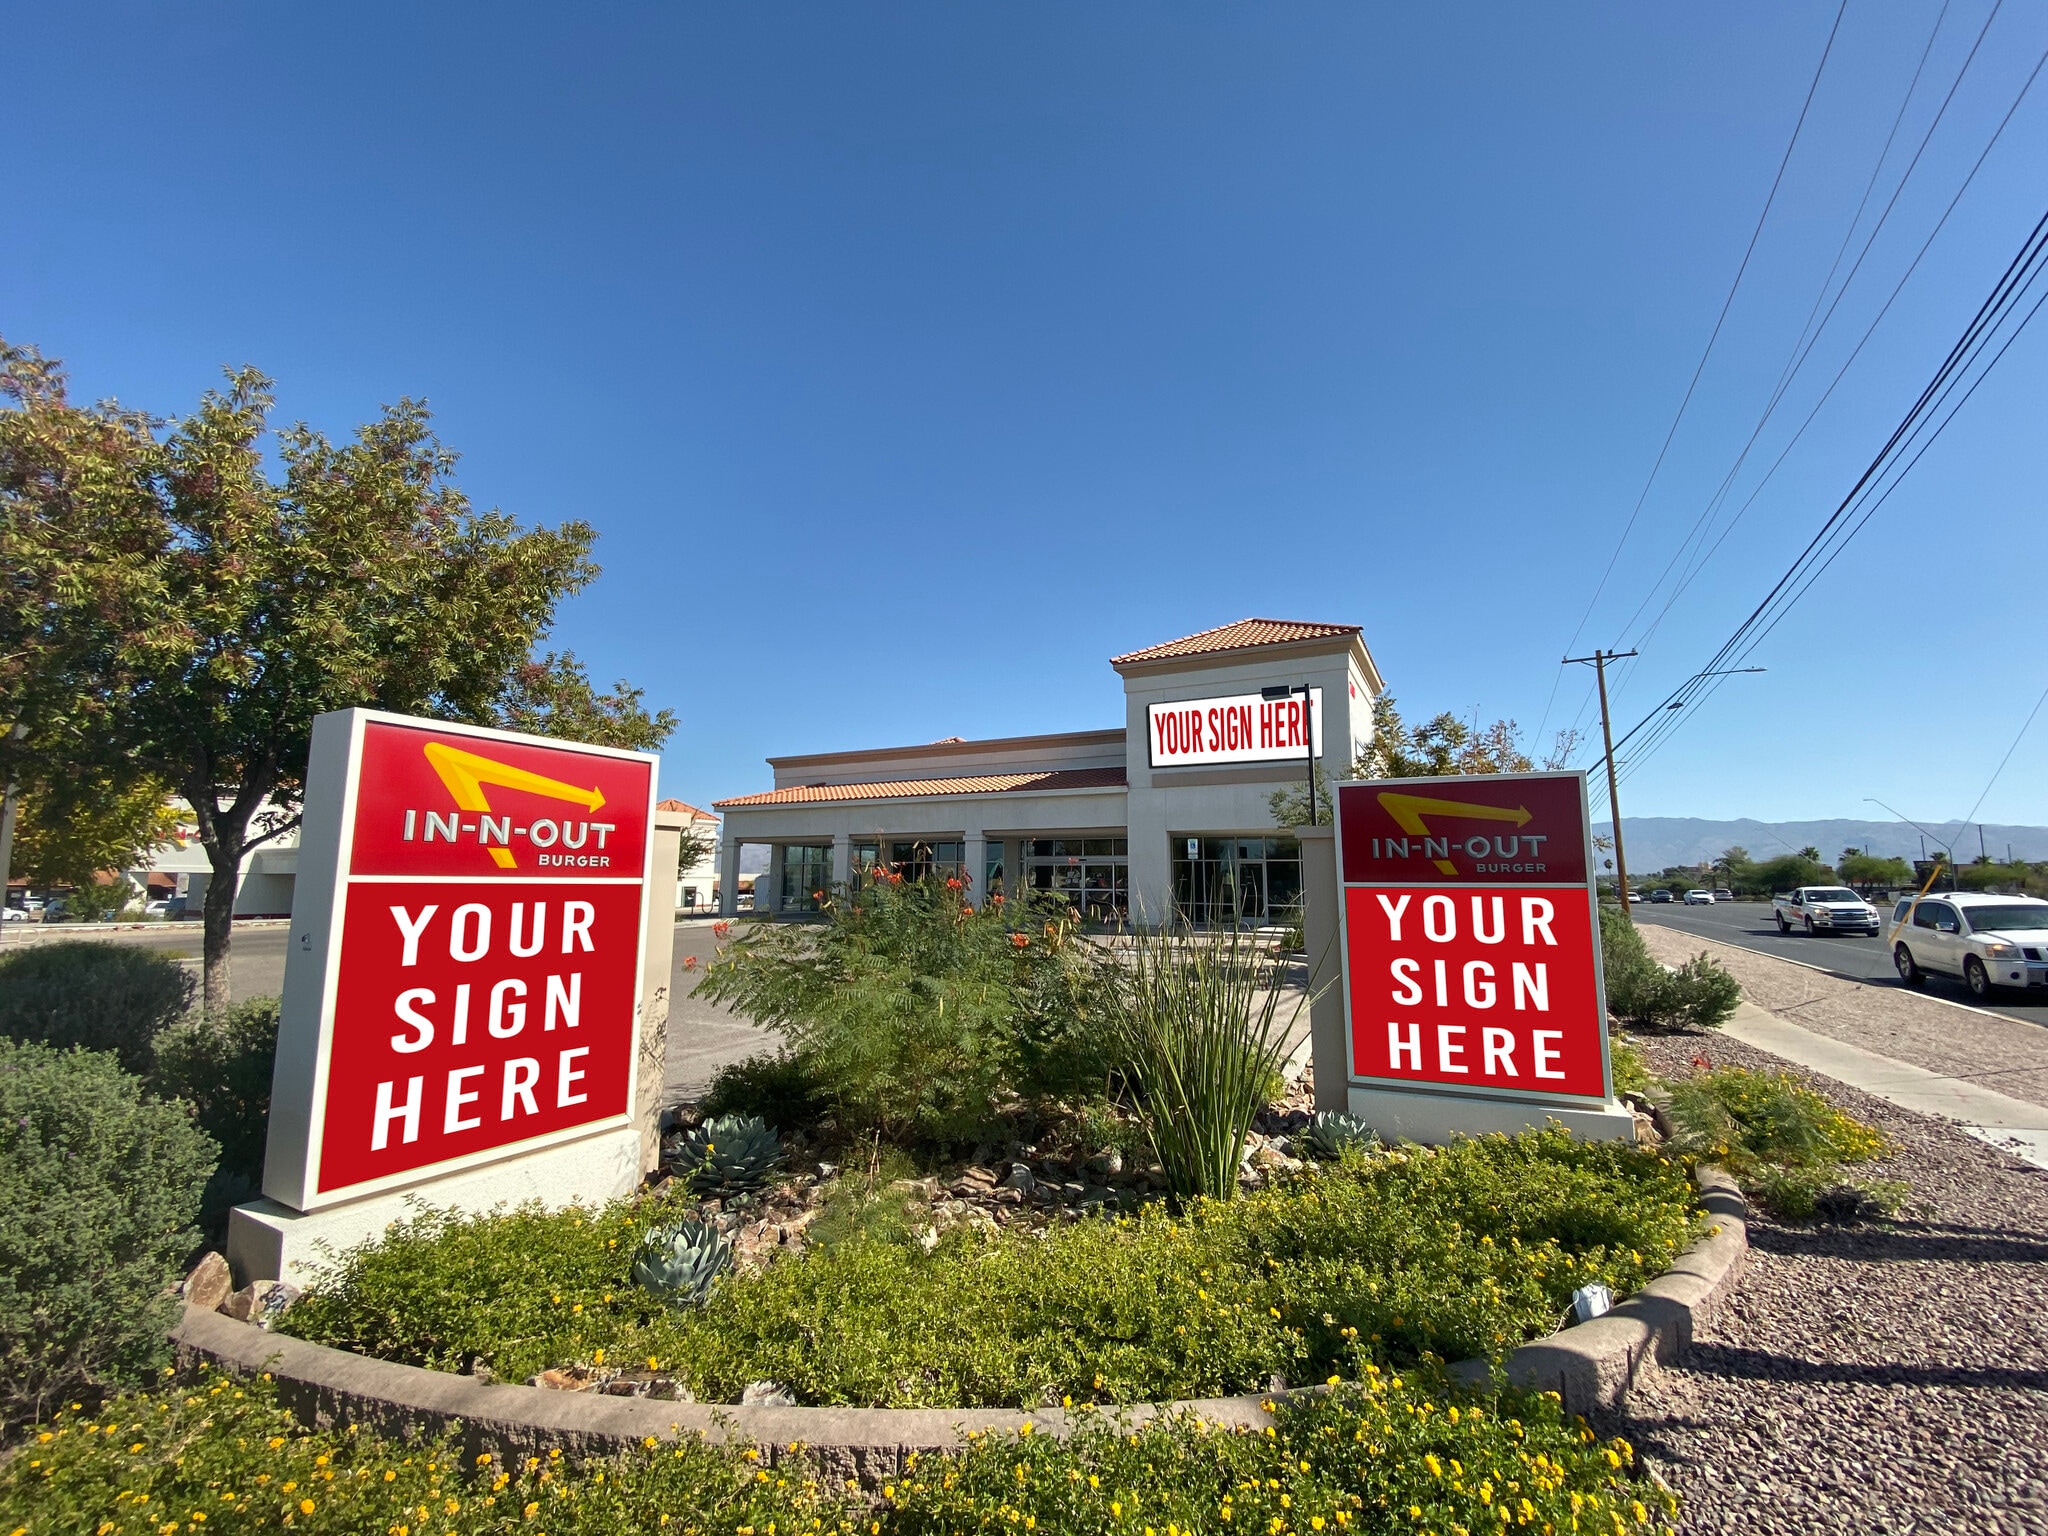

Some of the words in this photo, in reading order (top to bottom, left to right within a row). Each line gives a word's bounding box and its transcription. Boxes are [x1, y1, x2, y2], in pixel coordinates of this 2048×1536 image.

[1154, 709, 1205, 756] YOUR
[1207, 704, 1253, 753] SIGN
[403, 809, 616, 850] IN-N-OUT
[1372, 835, 1548, 859] IN-N-OUT
[538, 853, 611, 868] BURGER
[1476, 863, 1547, 873] BURGER
[390, 901, 595, 967] YOUR
[1376, 894, 1559, 946] YOUR
[1390, 957, 1550, 1012] SIGN
[391, 973, 582, 1054] SIGN
[1387, 1022, 1566, 1080] HERE
[371, 1046, 590, 1152] HERE
